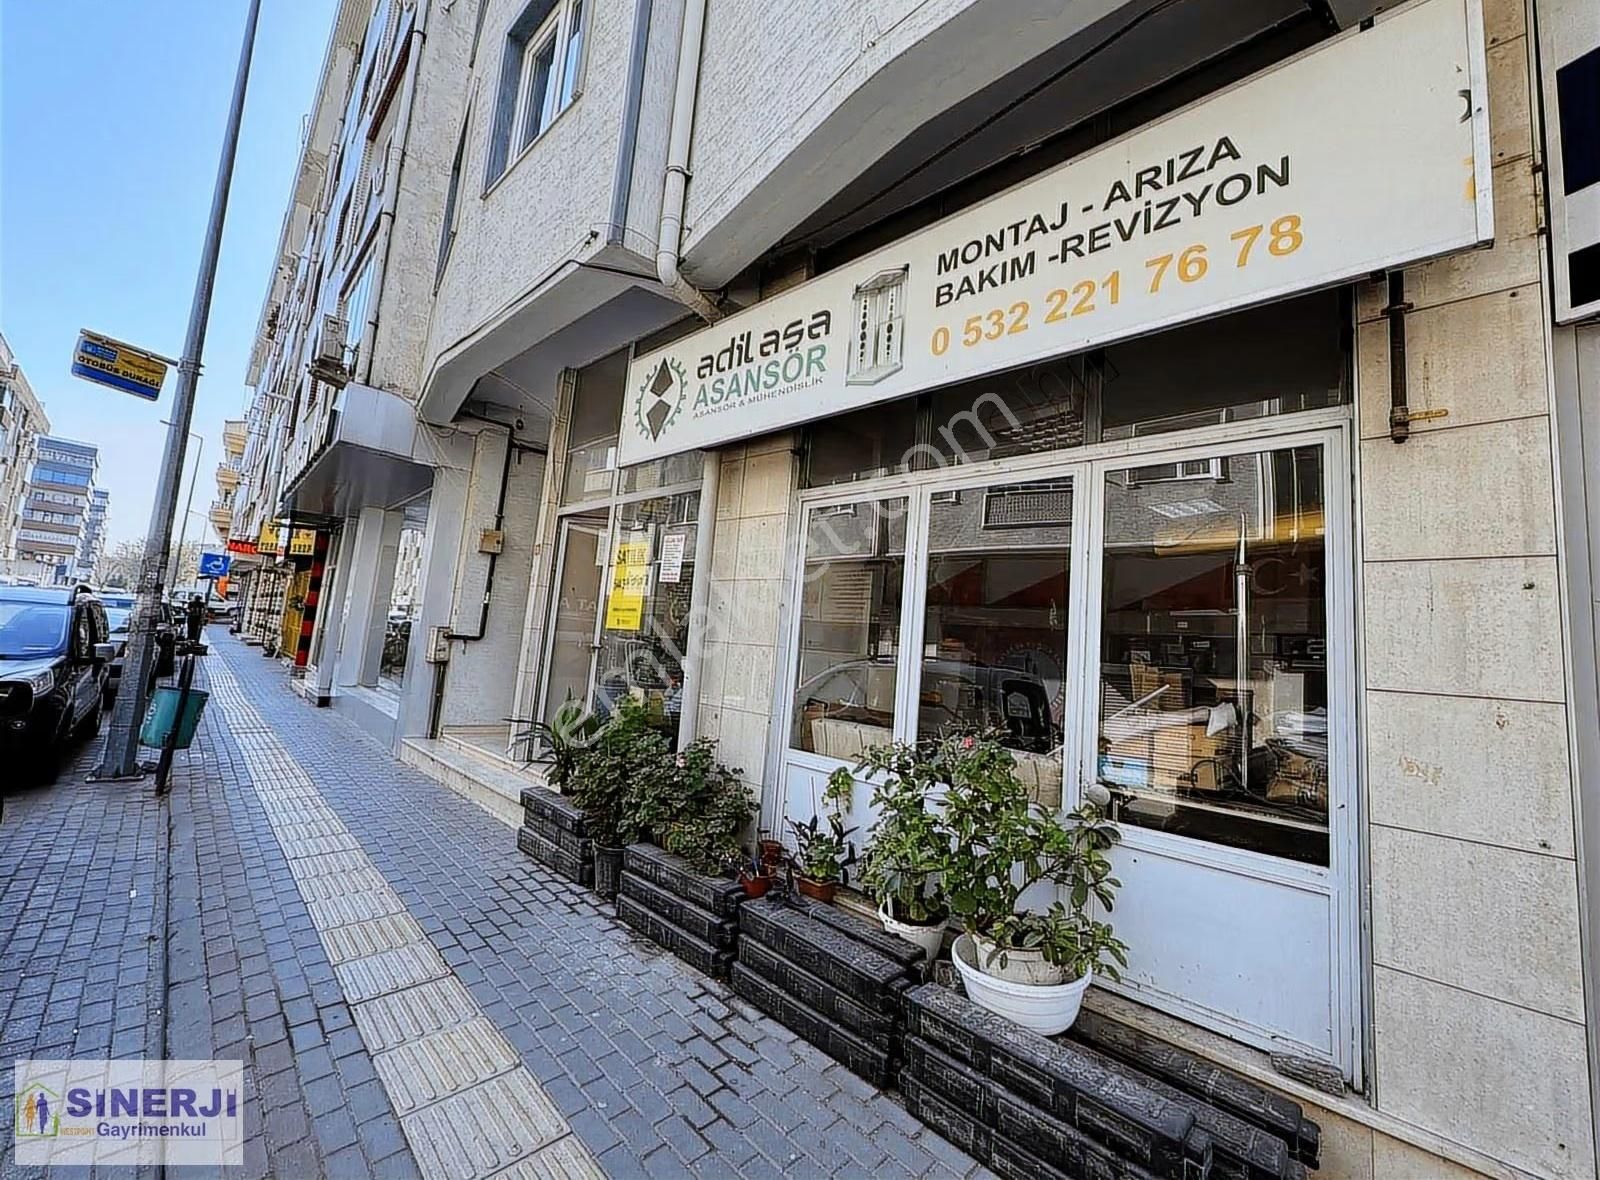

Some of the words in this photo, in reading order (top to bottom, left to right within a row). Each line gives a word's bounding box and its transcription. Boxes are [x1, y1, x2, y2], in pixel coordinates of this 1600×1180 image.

[937, 202, 1069, 275] MONTAJ
[1102, 136, 1241, 211] ARIZA
[931, 327, 950, 356] 0
[962, 301, 1030, 347] 532
[1044, 270, 1121, 324] 221
[1145, 244, 1209, 294] 76
[1230, 214, 1304, 268] 78
[935, 251, 1036, 308] BAKIM
[693, 344, 827, 409] ASANSÖR
[697, 330, 754, 379] adil
